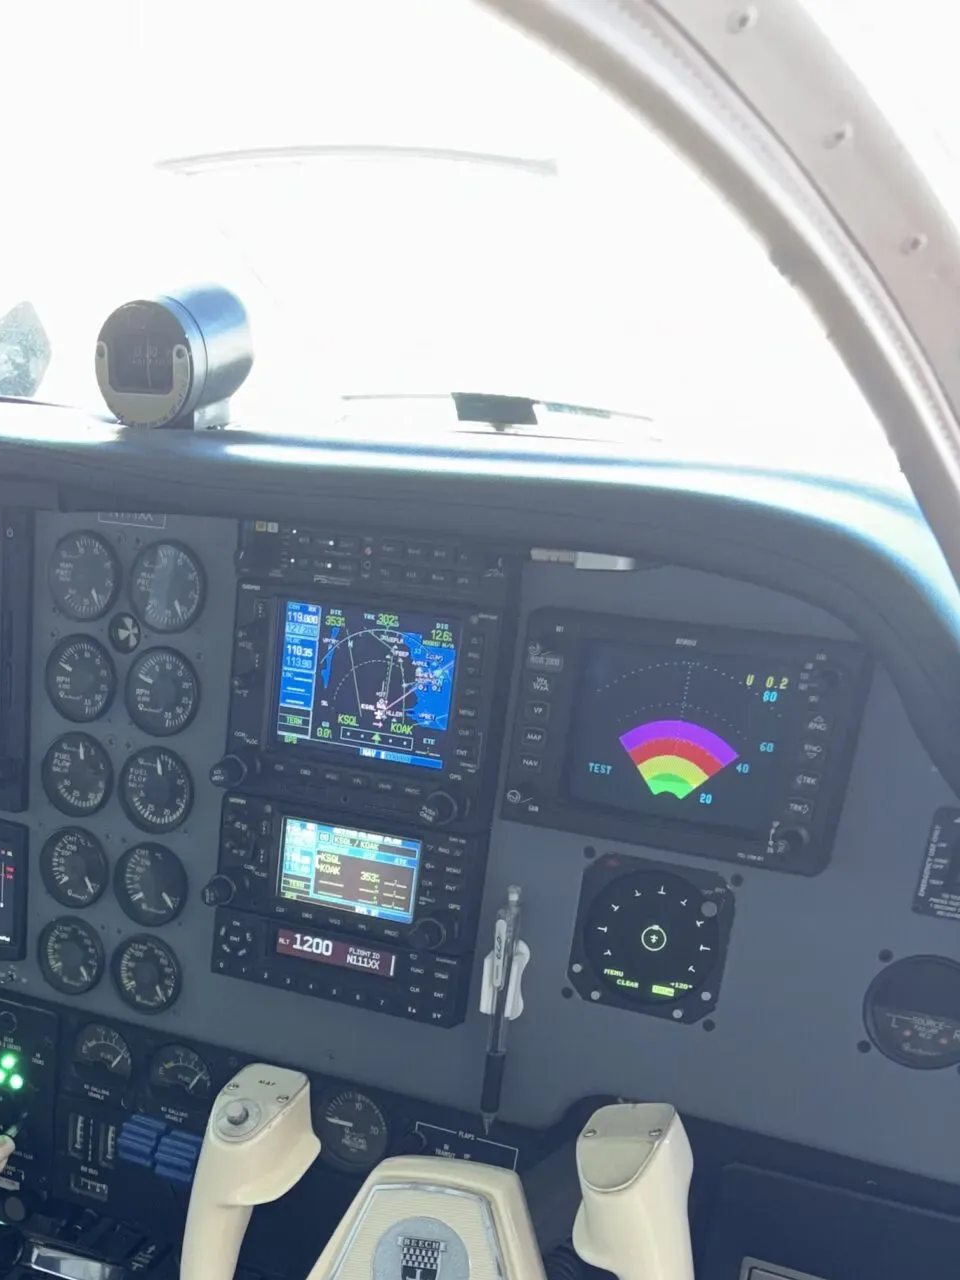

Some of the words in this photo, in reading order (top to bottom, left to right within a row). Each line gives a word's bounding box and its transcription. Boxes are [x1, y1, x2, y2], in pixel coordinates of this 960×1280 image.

[765, 676, 789, 690] 0.2
[762, 690, 778, 702] 80
[391, 722, 413, 735] KOAK
[759, 742, 774, 752] 60
[588, 762, 613, 775] TEST
[736, 763, 749, 774] 40
[700, 793, 712, 804] 20
[292, 933, 333, 957] 1200
[349, 947, 372, 956] FLIGHT
[372, 951, 380, 959] ID
[346, 954, 380, 970] N111XX
[604, 968, 624, 977] MENU
[616, 978, 639, 989] CLEAR
[912, 1016, 945, 1030] SOURCE
[458, 1131, 475, 1141] FLAPS
[403, 1238, 440, 1250] BEECH
